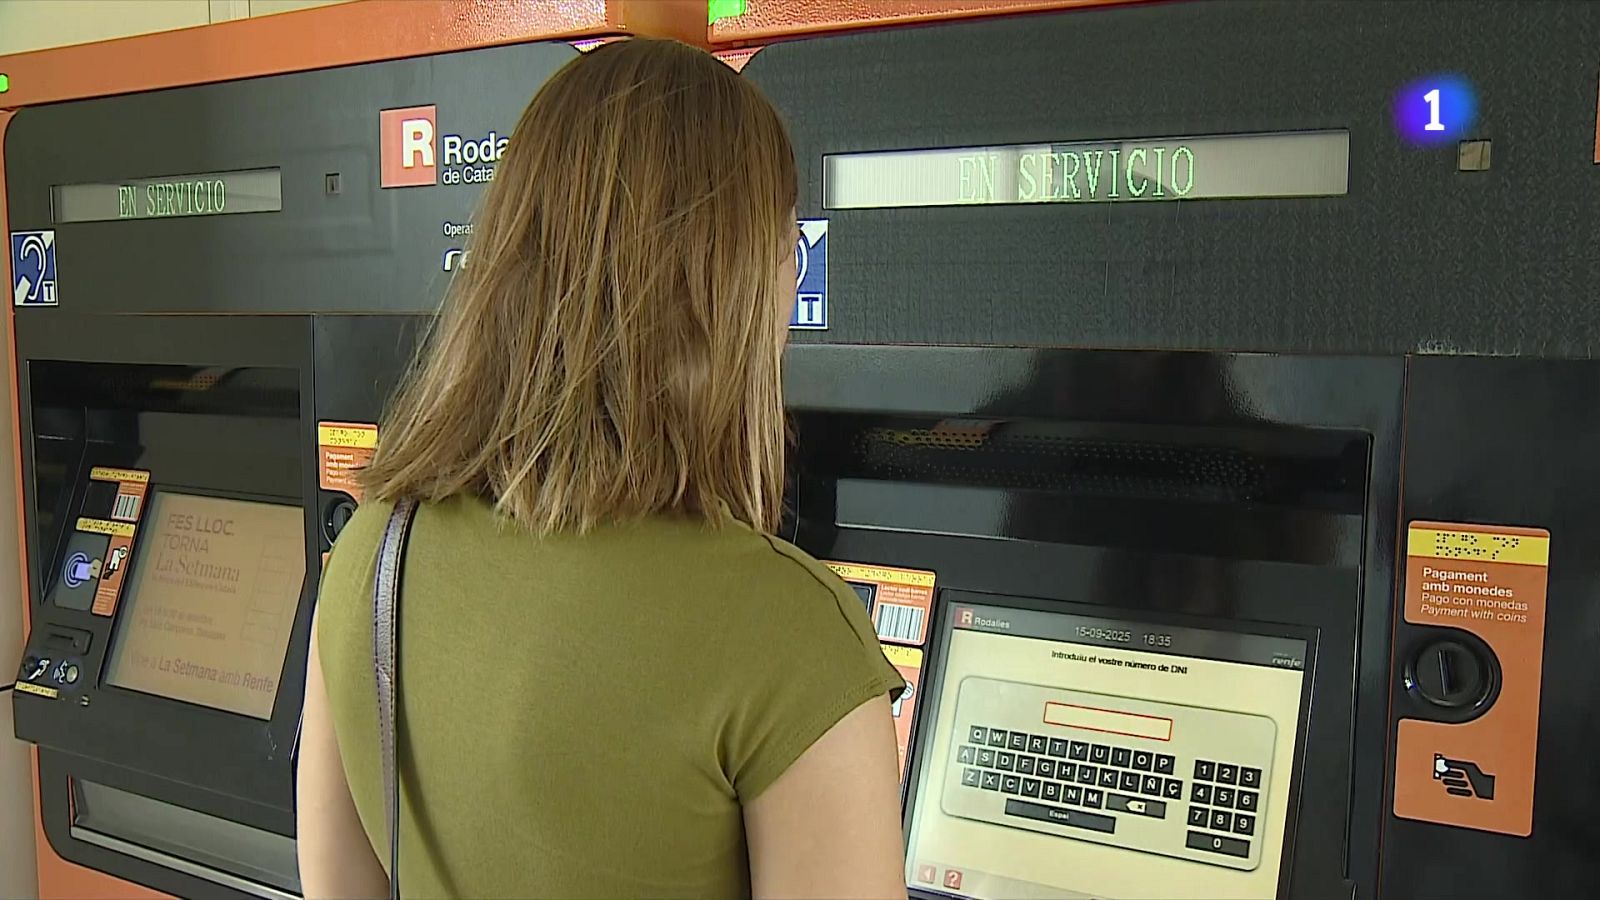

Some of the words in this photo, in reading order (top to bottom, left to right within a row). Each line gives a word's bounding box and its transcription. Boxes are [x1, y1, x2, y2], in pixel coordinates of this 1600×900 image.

[402, 119, 434, 168] R
[443, 168, 460, 184] de
[958, 154, 999, 201] EN
[1018, 146, 1195, 201] SERVICIO
[118, 186, 137, 217] EN
[146, 179, 226, 216] SERVICIO
[44, 283, 54, 300] T
[802, 296, 819, 322] T
[168, 513, 194, 531] FES
[161, 533, 209, 554] TORNA
[155, 552, 174, 572] La
[176, 556, 240, 582] Setmana
[1423, 566, 1488, 582] Pagament
[1422, 582, 1450, 592] amb
[1453, 585, 1513, 598] monedes
[1421, 592, 1450, 605] Pago
[1452, 597, 1473, 606] con
[1476, 597, 1528, 611] monedas
[961, 610, 973, 625] R
[1420, 604, 1468, 618] Payment
[1471, 609, 1494, 620] with
[1497, 612, 1527, 623] coins
[1075, 626, 1132, 642] 15-09-2025
[159, 655, 171, 672] La
[173, 658, 218, 681] Setmana
[218, 671, 241, 686] amb
[243, 672, 274, 692] Renfe
[1088, 655, 1097, 663] el
[1098, 657, 1122, 667] vostre
[1158, 664, 1169, 672] de
[1171, 664, 1188, 675] DNI
[973, 729, 982, 739] Q
[992, 732, 1003, 742] W
[1013, 735, 1021, 745] E
[1033, 738, 1041, 748] R
[1054, 742, 1062, 751] T
[1074, 745, 1083, 754] Y
[1095, 748, 1104, 758] U
[1118, 752, 1122, 761] I
[1137, 755, 1146, 765] O
[1160, 758, 1168, 768] P
[961, 749, 969, 759] A
[981, 752, 989, 762] S
[1001, 755, 1009, 765] D
[1021, 759, 1029, 768] F
[1041, 762, 1050, 772] G
[1062, 766, 1070, 775] H
[1083, 769, 1091, 779] J
[1103, 772, 1112, 783] K
[1125, 776, 1133, 786] L
[1147, 778, 1156, 790] Ñ
[1169, 783, 1178, 795] Ç
[1201, 765, 1207, 775] 1
[1222, 768, 1231, 778] 2
[1245, 771, 1253, 781] 3
[967, 772, 975, 782] Z
[986, 775, 994, 785] X
[1006, 779, 1015, 788] C
[1026, 782, 1034, 791] V
[1047, 785, 1055, 795] B
[1067, 789, 1076, 799] N
[1088, 792, 1097, 803] M
[1196, 788, 1204, 798] 4
[1220, 792, 1228, 801] 5
[1243, 795, 1251, 805] 6
[1194, 810, 1202, 820] 7
[1216, 814, 1224, 825] 8
[1240, 818, 1248, 828] 9
[1213, 838, 1221, 848] 0
